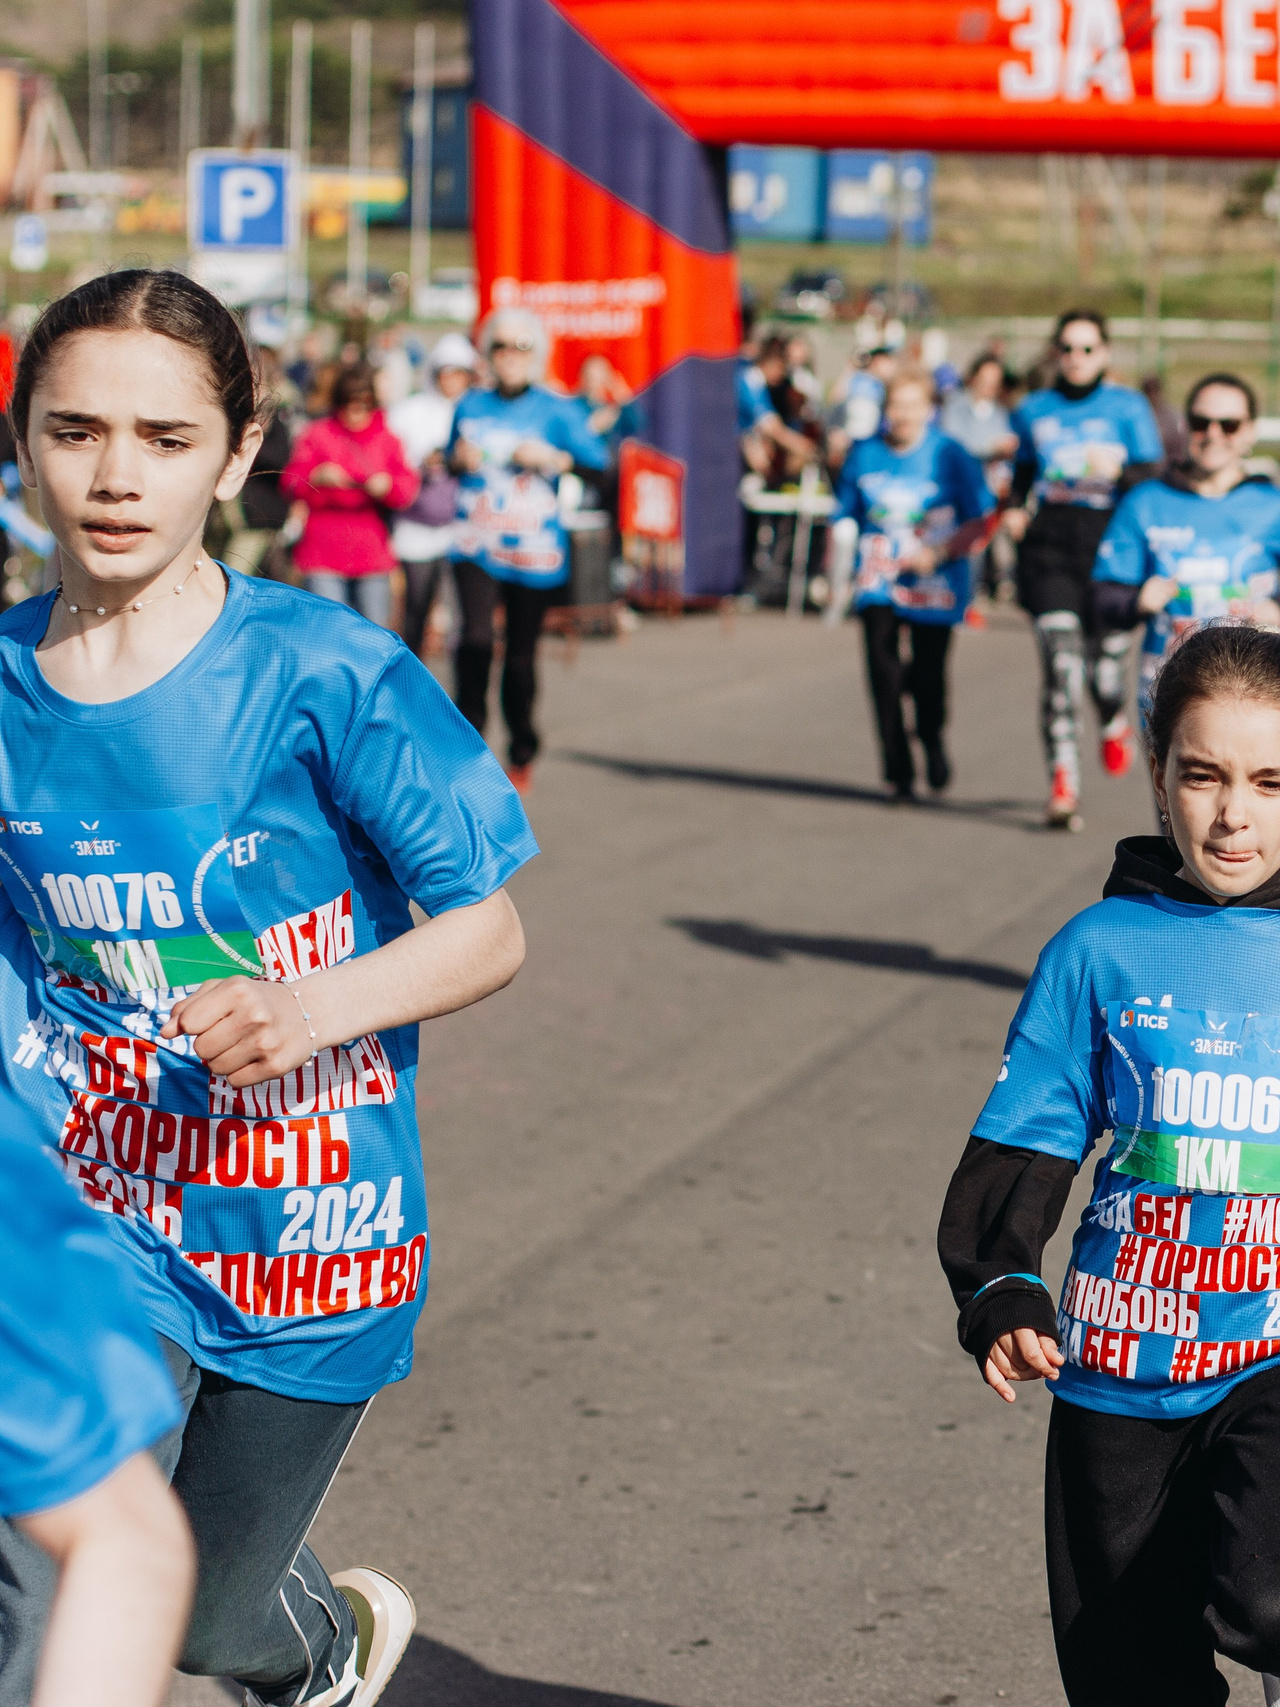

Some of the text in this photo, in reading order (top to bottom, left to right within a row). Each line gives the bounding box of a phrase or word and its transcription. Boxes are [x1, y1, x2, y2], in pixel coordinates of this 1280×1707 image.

[219, 166, 277, 242] P
[9, 821, 43, 835] ПСБ
[41, 872, 184, 932] 10076
[1137, 1013, 1168, 1029] ПСБ
[63, 1090, 350, 1189] #ГОРДОСТЬ
[279, 1176, 404, 1253] 2024
[1062, 1265, 1199, 1339] #ЛЮБОВЬ
